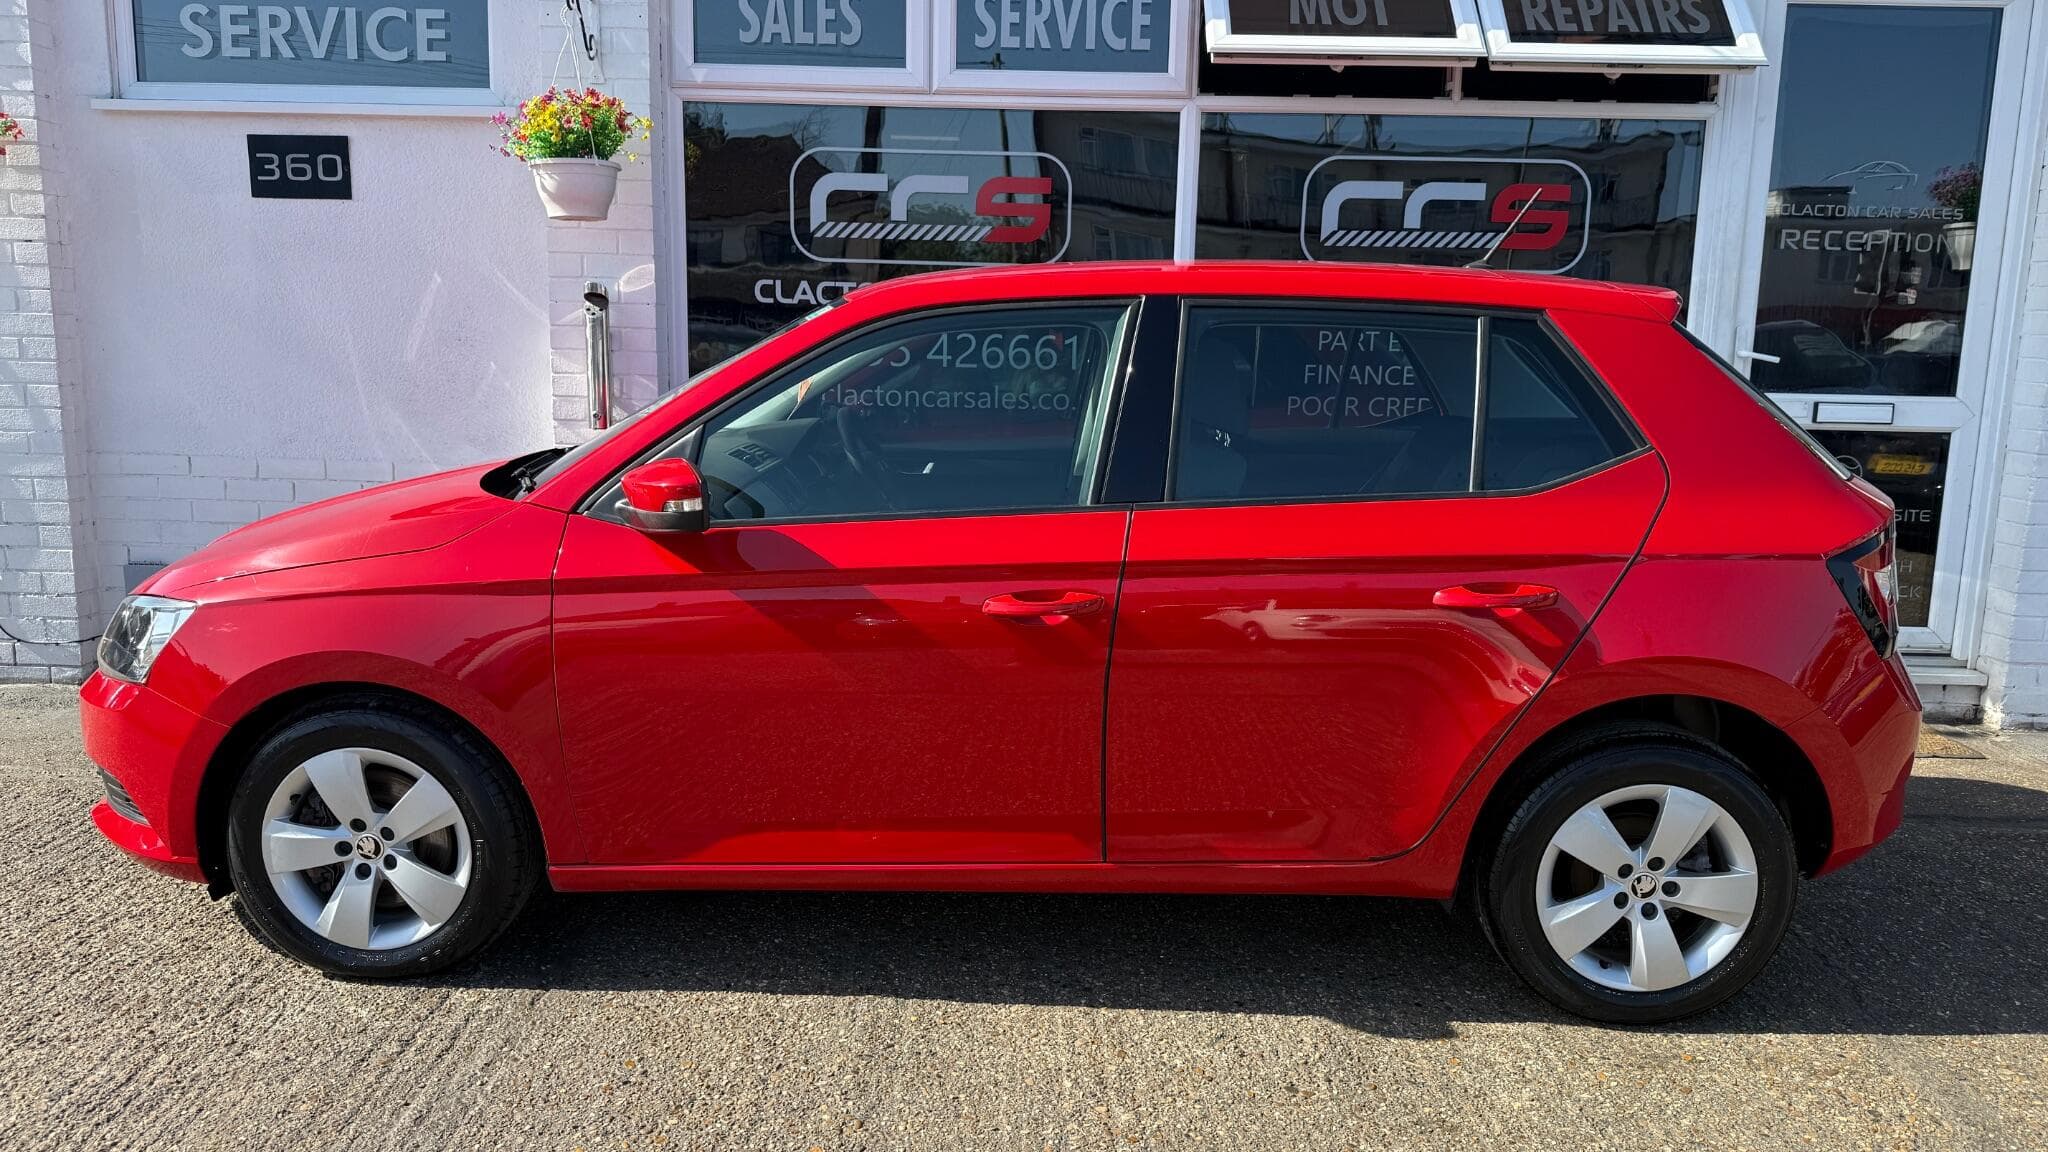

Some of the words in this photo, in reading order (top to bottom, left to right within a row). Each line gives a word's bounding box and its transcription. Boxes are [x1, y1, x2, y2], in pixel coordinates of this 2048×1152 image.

[179, 3, 447, 62] SERVICE
[738, 0, 863, 46] SALES
[974, 0, 1152, 51] SERVICE
[1524, 0, 1711, 34] REPAIRS
[255, 153, 343, 181] 360
[1780, 203, 1859, 217] CLACTON
[1866, 206, 1901, 218] CAR
[1908, 207, 1965, 221] SALES
[1779, 229, 1954, 254] RECEPTION
[754, 279, 872, 305] CLACT
[926, 332, 1079, 371] 426661
[1304, 364, 1415, 386] FINANCE
